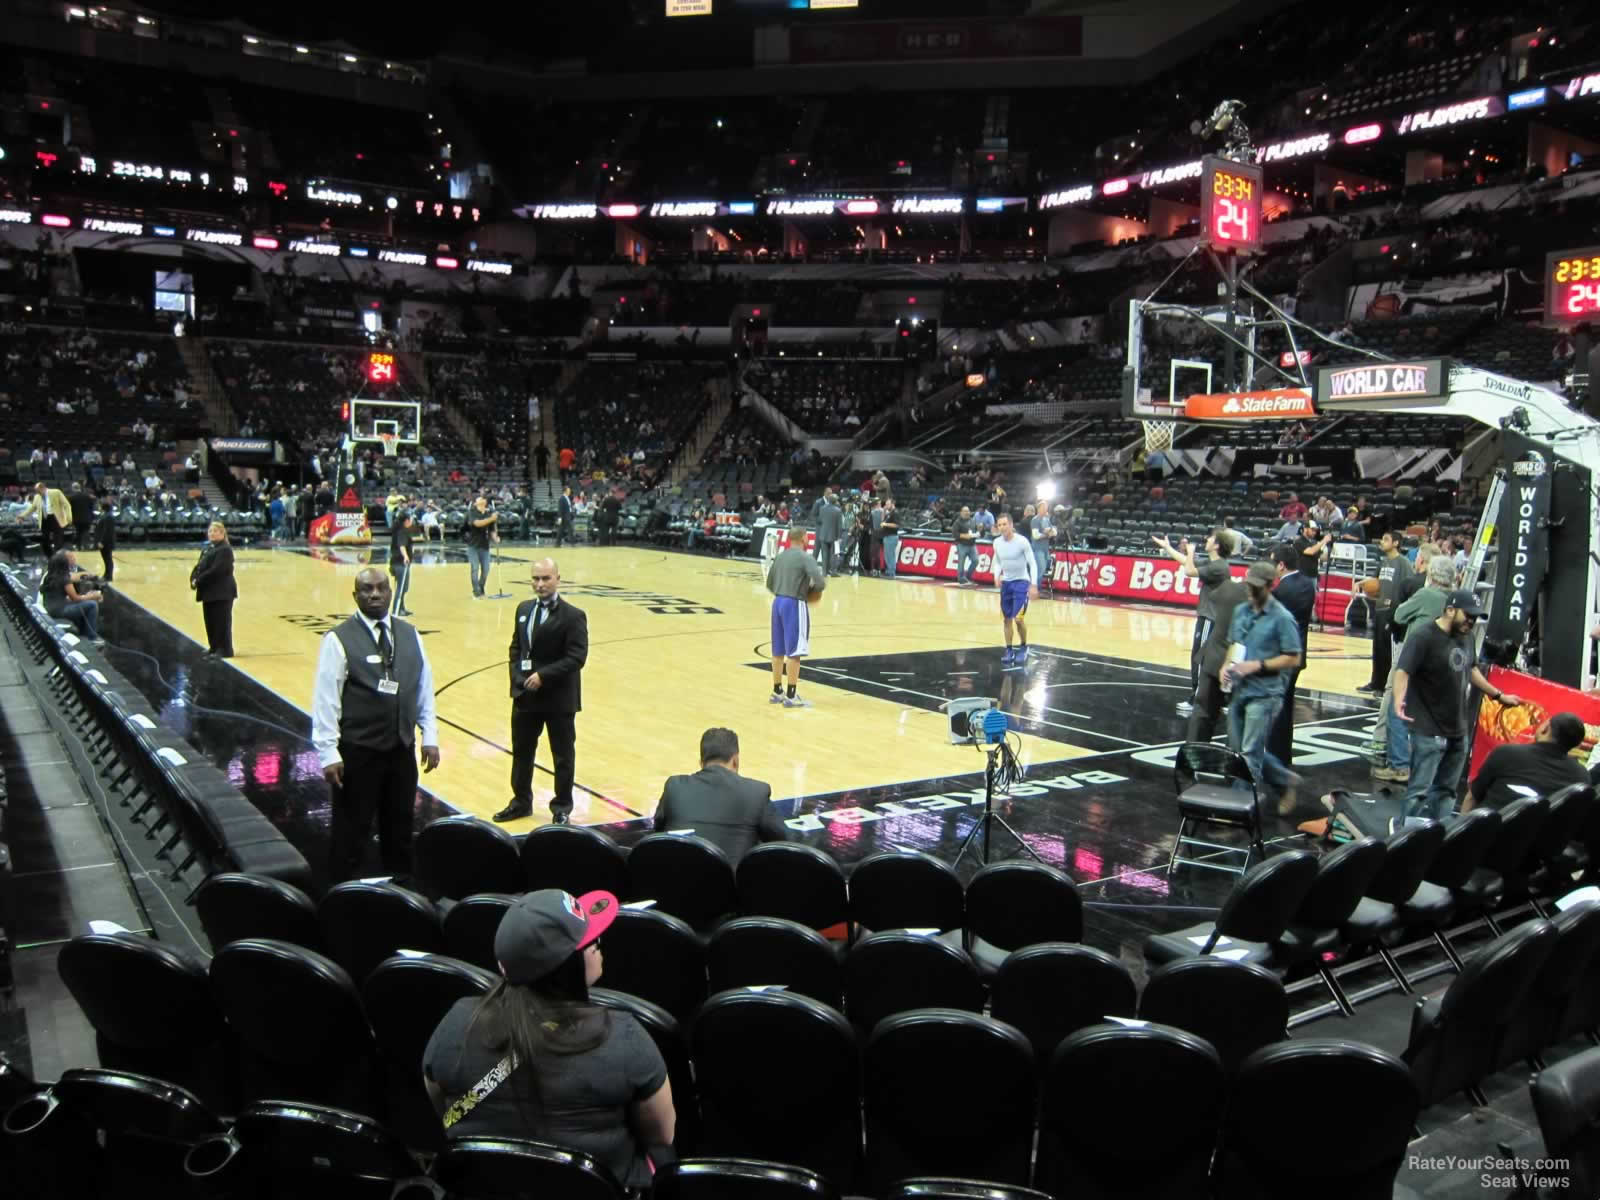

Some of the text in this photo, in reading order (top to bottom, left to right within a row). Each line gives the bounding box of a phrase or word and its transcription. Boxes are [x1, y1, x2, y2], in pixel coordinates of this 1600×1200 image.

[1410, 98, 1490, 132] PLAYOFFS
[1265, 134, 1330, 161] PLAYOFFS
[111, 160, 164, 180] 23:34
[169, 169, 192, 182] PER
[200, 172, 210, 186] 1
[1149, 161, 1203, 185] PLAYOFFS
[307, 186, 363, 205] Lakers
[1046, 185, 1094, 207] PLAYOFFS
[1213, 171, 1252, 201] 23:34
[542, 204, 598, 219] PLAYOFFS
[659, 202, 717, 217] PLAYOFFS
[776, 200, 835, 215] PLAYOFFS
[902, 198, 963, 213] PLAYOFFS
[1216, 200, 1249, 241] 24
[1568, 285, 1600, 313] 24
[372, 363, 391, 379] 24
[1331, 367, 1425, 396] WORLD CAR
[1483, 376, 1532, 401] SPALDING
[216, 440, 269, 449] BUD LIGHT
[336, 512, 364, 520] BRAKE
[336, 520, 364, 528] CHECK
[1514, 487, 1537, 567] WORLD
[1509, 573, 1526, 620] CAR
